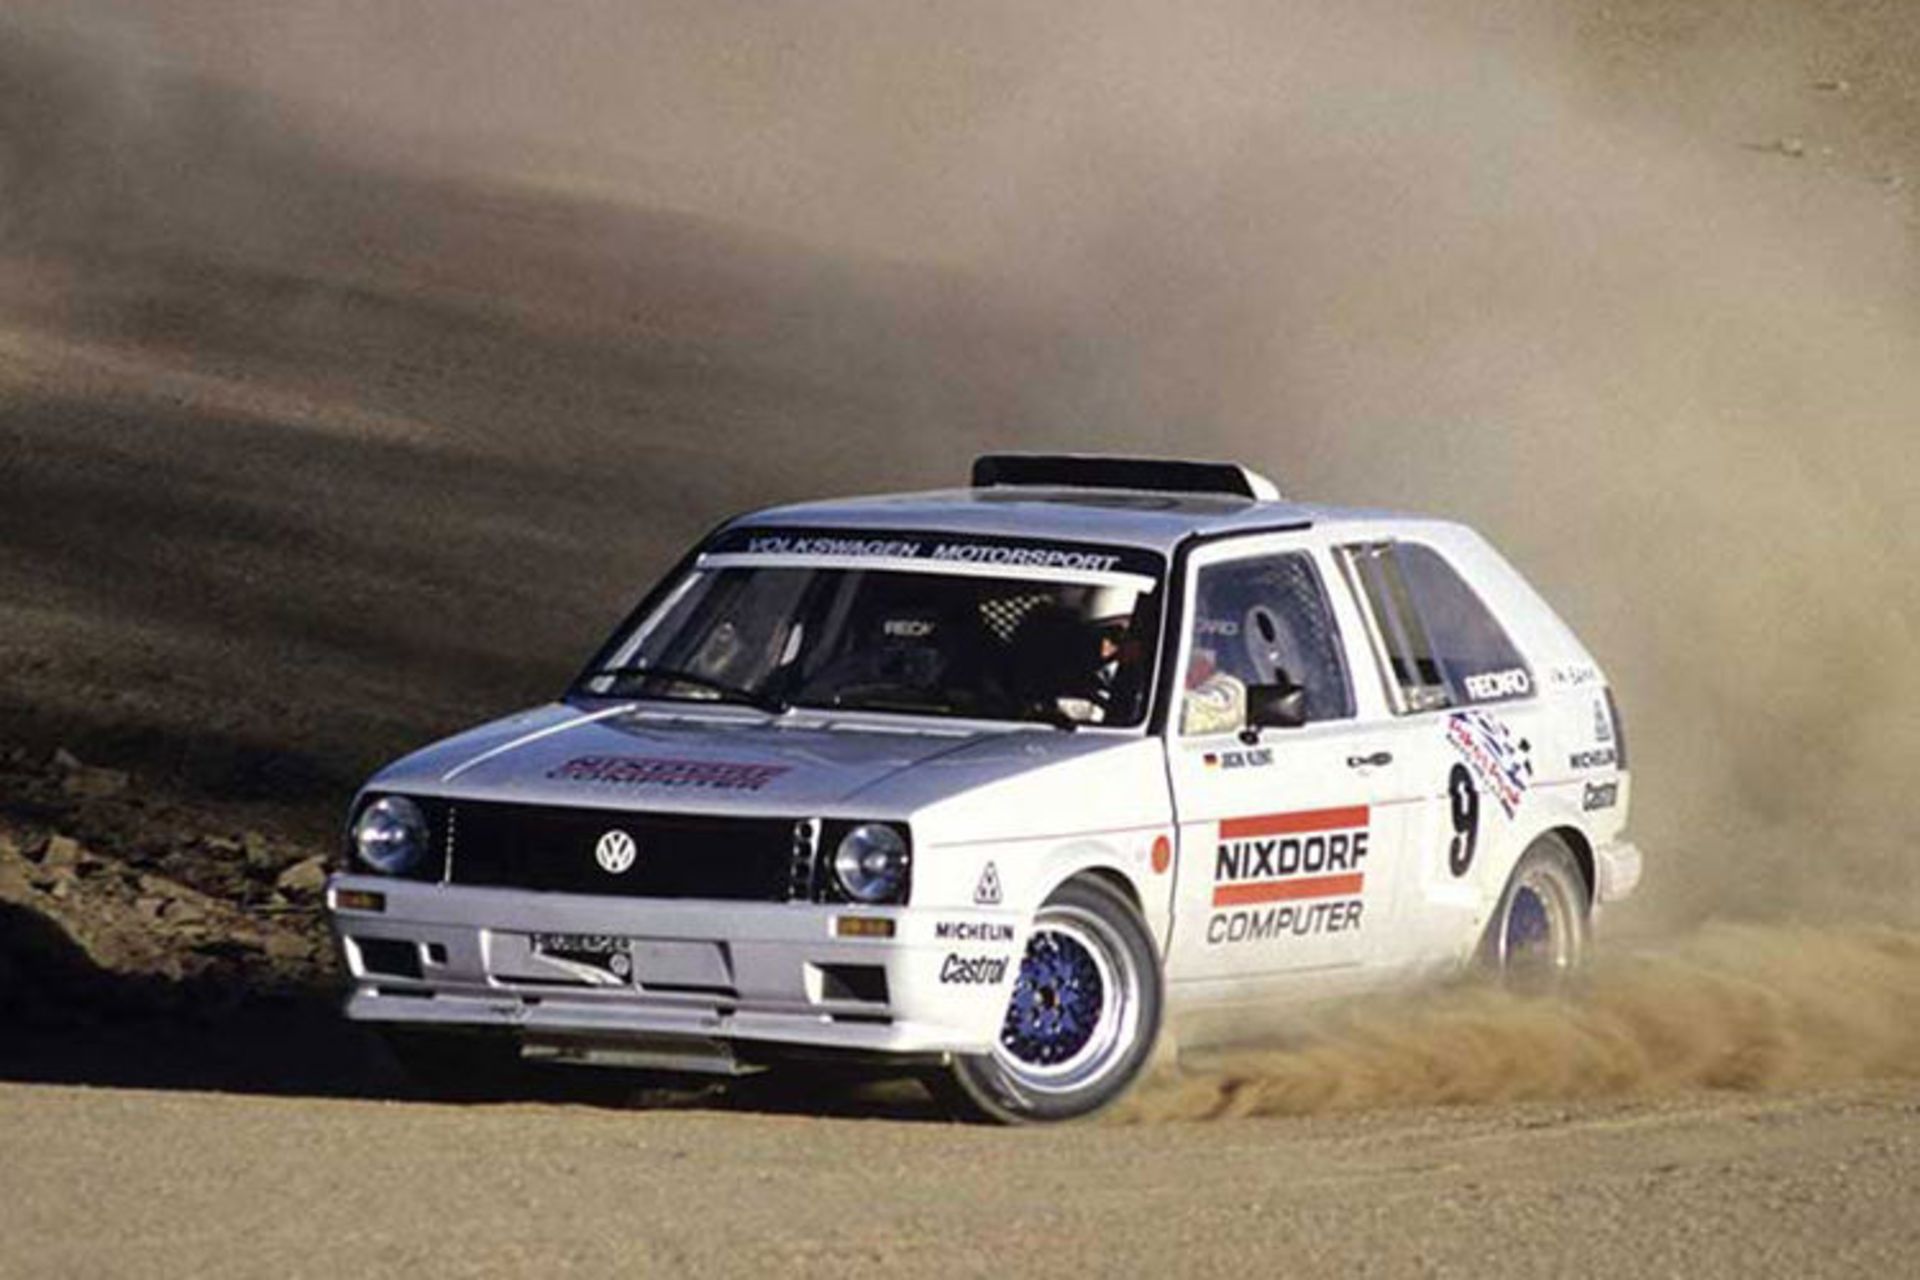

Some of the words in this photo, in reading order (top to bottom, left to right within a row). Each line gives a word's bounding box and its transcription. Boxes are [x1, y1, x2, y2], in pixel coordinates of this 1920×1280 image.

[749, 538, 921, 557] VOLKSWAGEN
[932, 544, 1121, 571] MOTORSPORT
[1464, 668, 1528, 700] RECARO
[1449, 762, 1479, 877] 9
[1215, 832, 1368, 880] NIXDORF
[936, 922, 1014, 941] MICHELIN
[1206, 900, 1364, 945] COMPUTER
[940, 952, 1010, 984] Castrol
